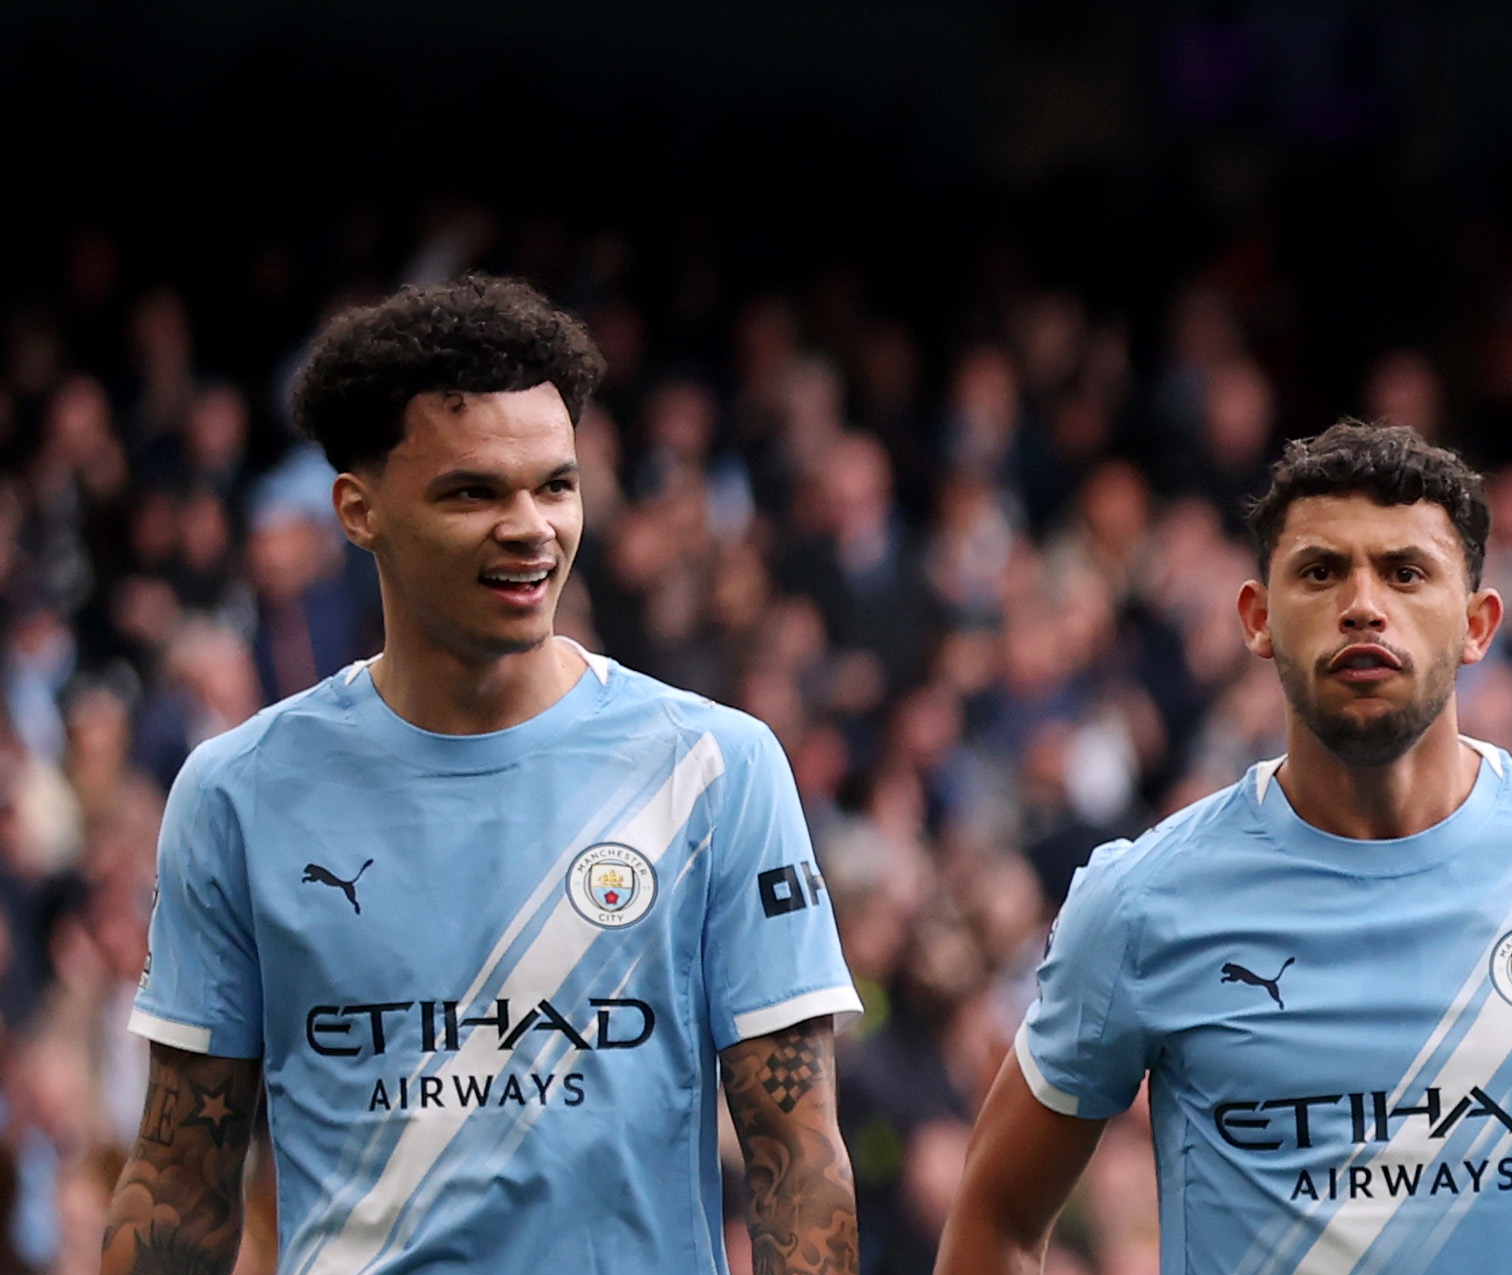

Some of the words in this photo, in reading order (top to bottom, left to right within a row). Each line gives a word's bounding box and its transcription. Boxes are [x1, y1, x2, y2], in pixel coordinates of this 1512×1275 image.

[577, 849, 648, 877] MANCHESTER
[598, 913, 625, 922] CITY
[306, 998, 656, 1057] ETIHAD
[369, 1073, 586, 1112] AIRWAYS
